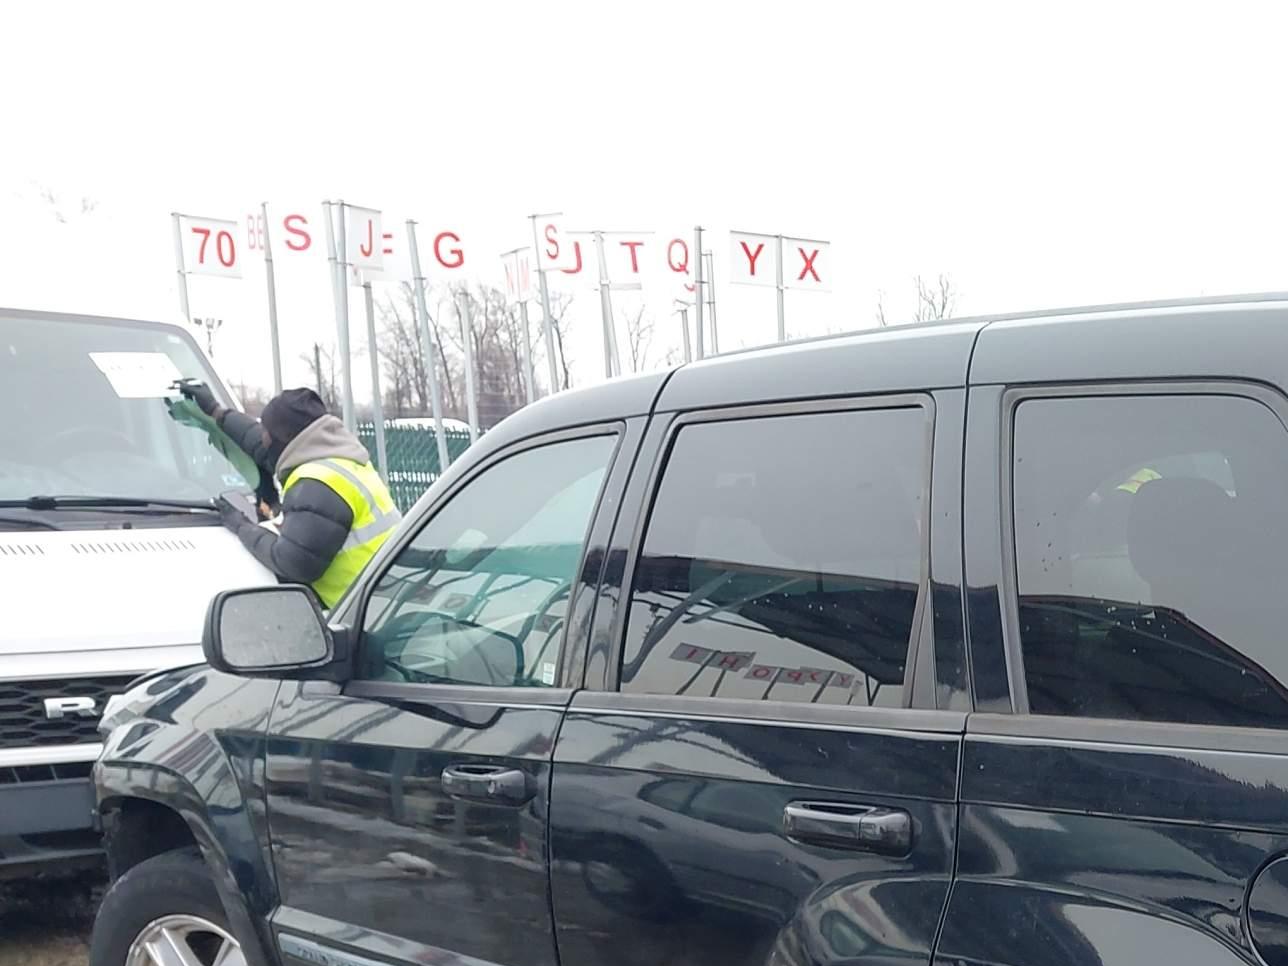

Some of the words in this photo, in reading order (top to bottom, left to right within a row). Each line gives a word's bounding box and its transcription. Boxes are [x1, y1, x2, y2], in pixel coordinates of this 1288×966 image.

[191, 227, 236, 267] 70
[283, 214, 312, 251] S
[360, 219, 373, 257] J
[433, 231, 466, 269] G
[545, 224, 560, 260] S
[620, 241, 644, 274] T
[667, 238, 690, 275] Q
[740, 241, 764, 276] Y
[797, 247, 822, 283] X
